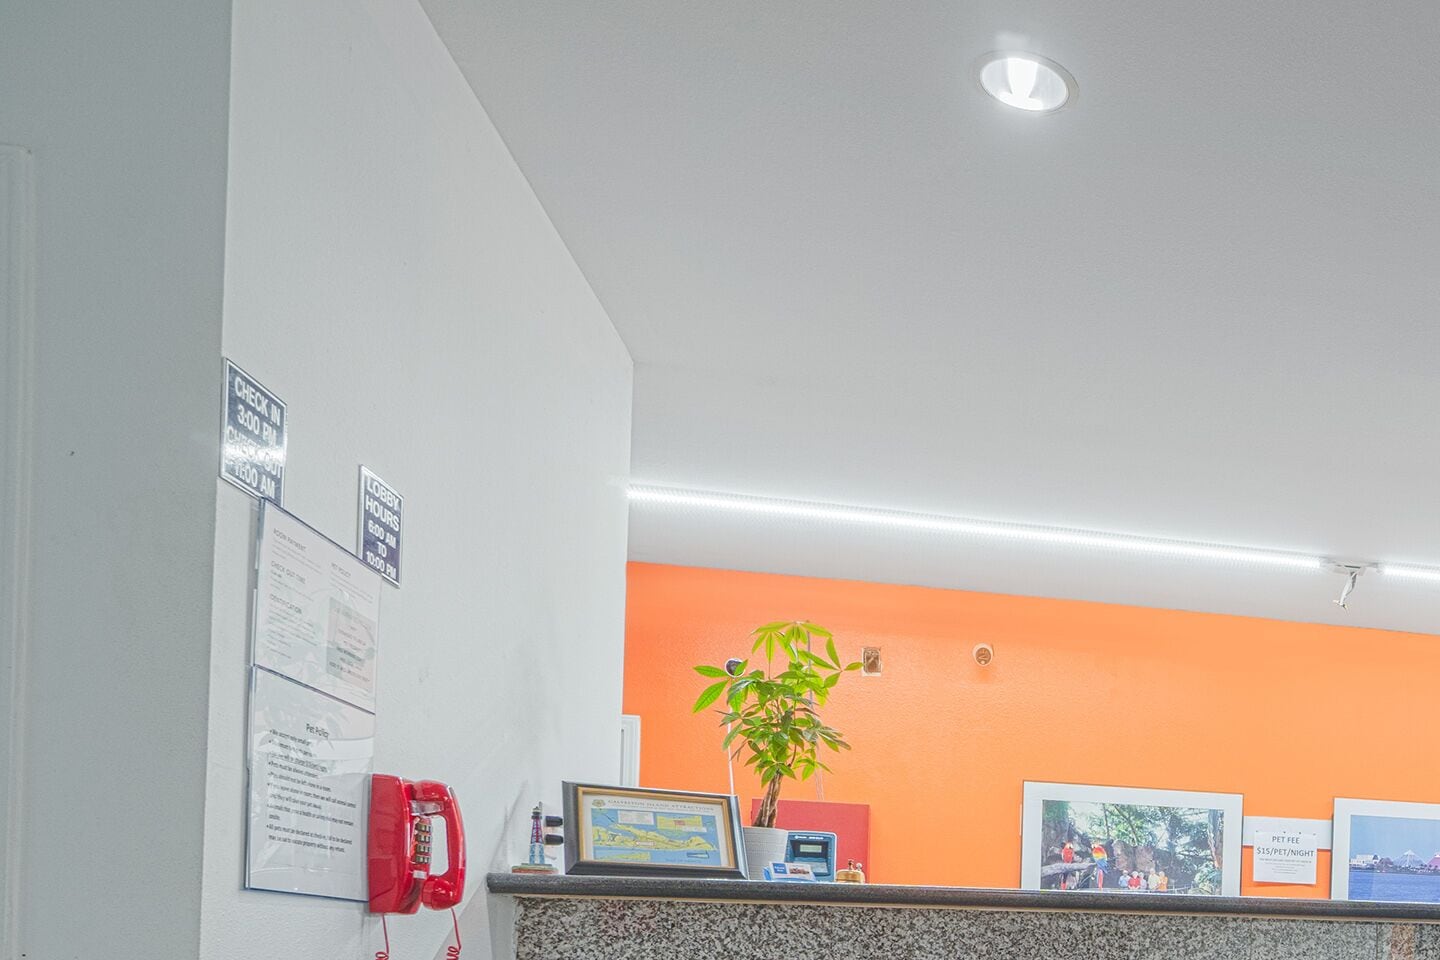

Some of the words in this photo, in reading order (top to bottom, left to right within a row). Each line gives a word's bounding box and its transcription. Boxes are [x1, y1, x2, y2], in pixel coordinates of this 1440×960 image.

[235, 376, 268, 418] CHECK
[270, 403, 281, 427] IN
[237, 404, 260, 435] 3:00
[262, 422, 278, 447] PM
[260, 475, 276, 499] AM
[366, 475, 400, 511] LOBBY
[365, 494, 400, 532] HOURS
[377, 541, 387, 558] TO
[385, 532, 397, 549] AM
[366, 550, 385, 572] 10:00
[386, 563, 397, 580] PM
[1256, 846, 1315, 857] $15/PET/NIGHT
[1272, 836, 1285, 844] PET
[1287, 836, 1300, 845] FEE
